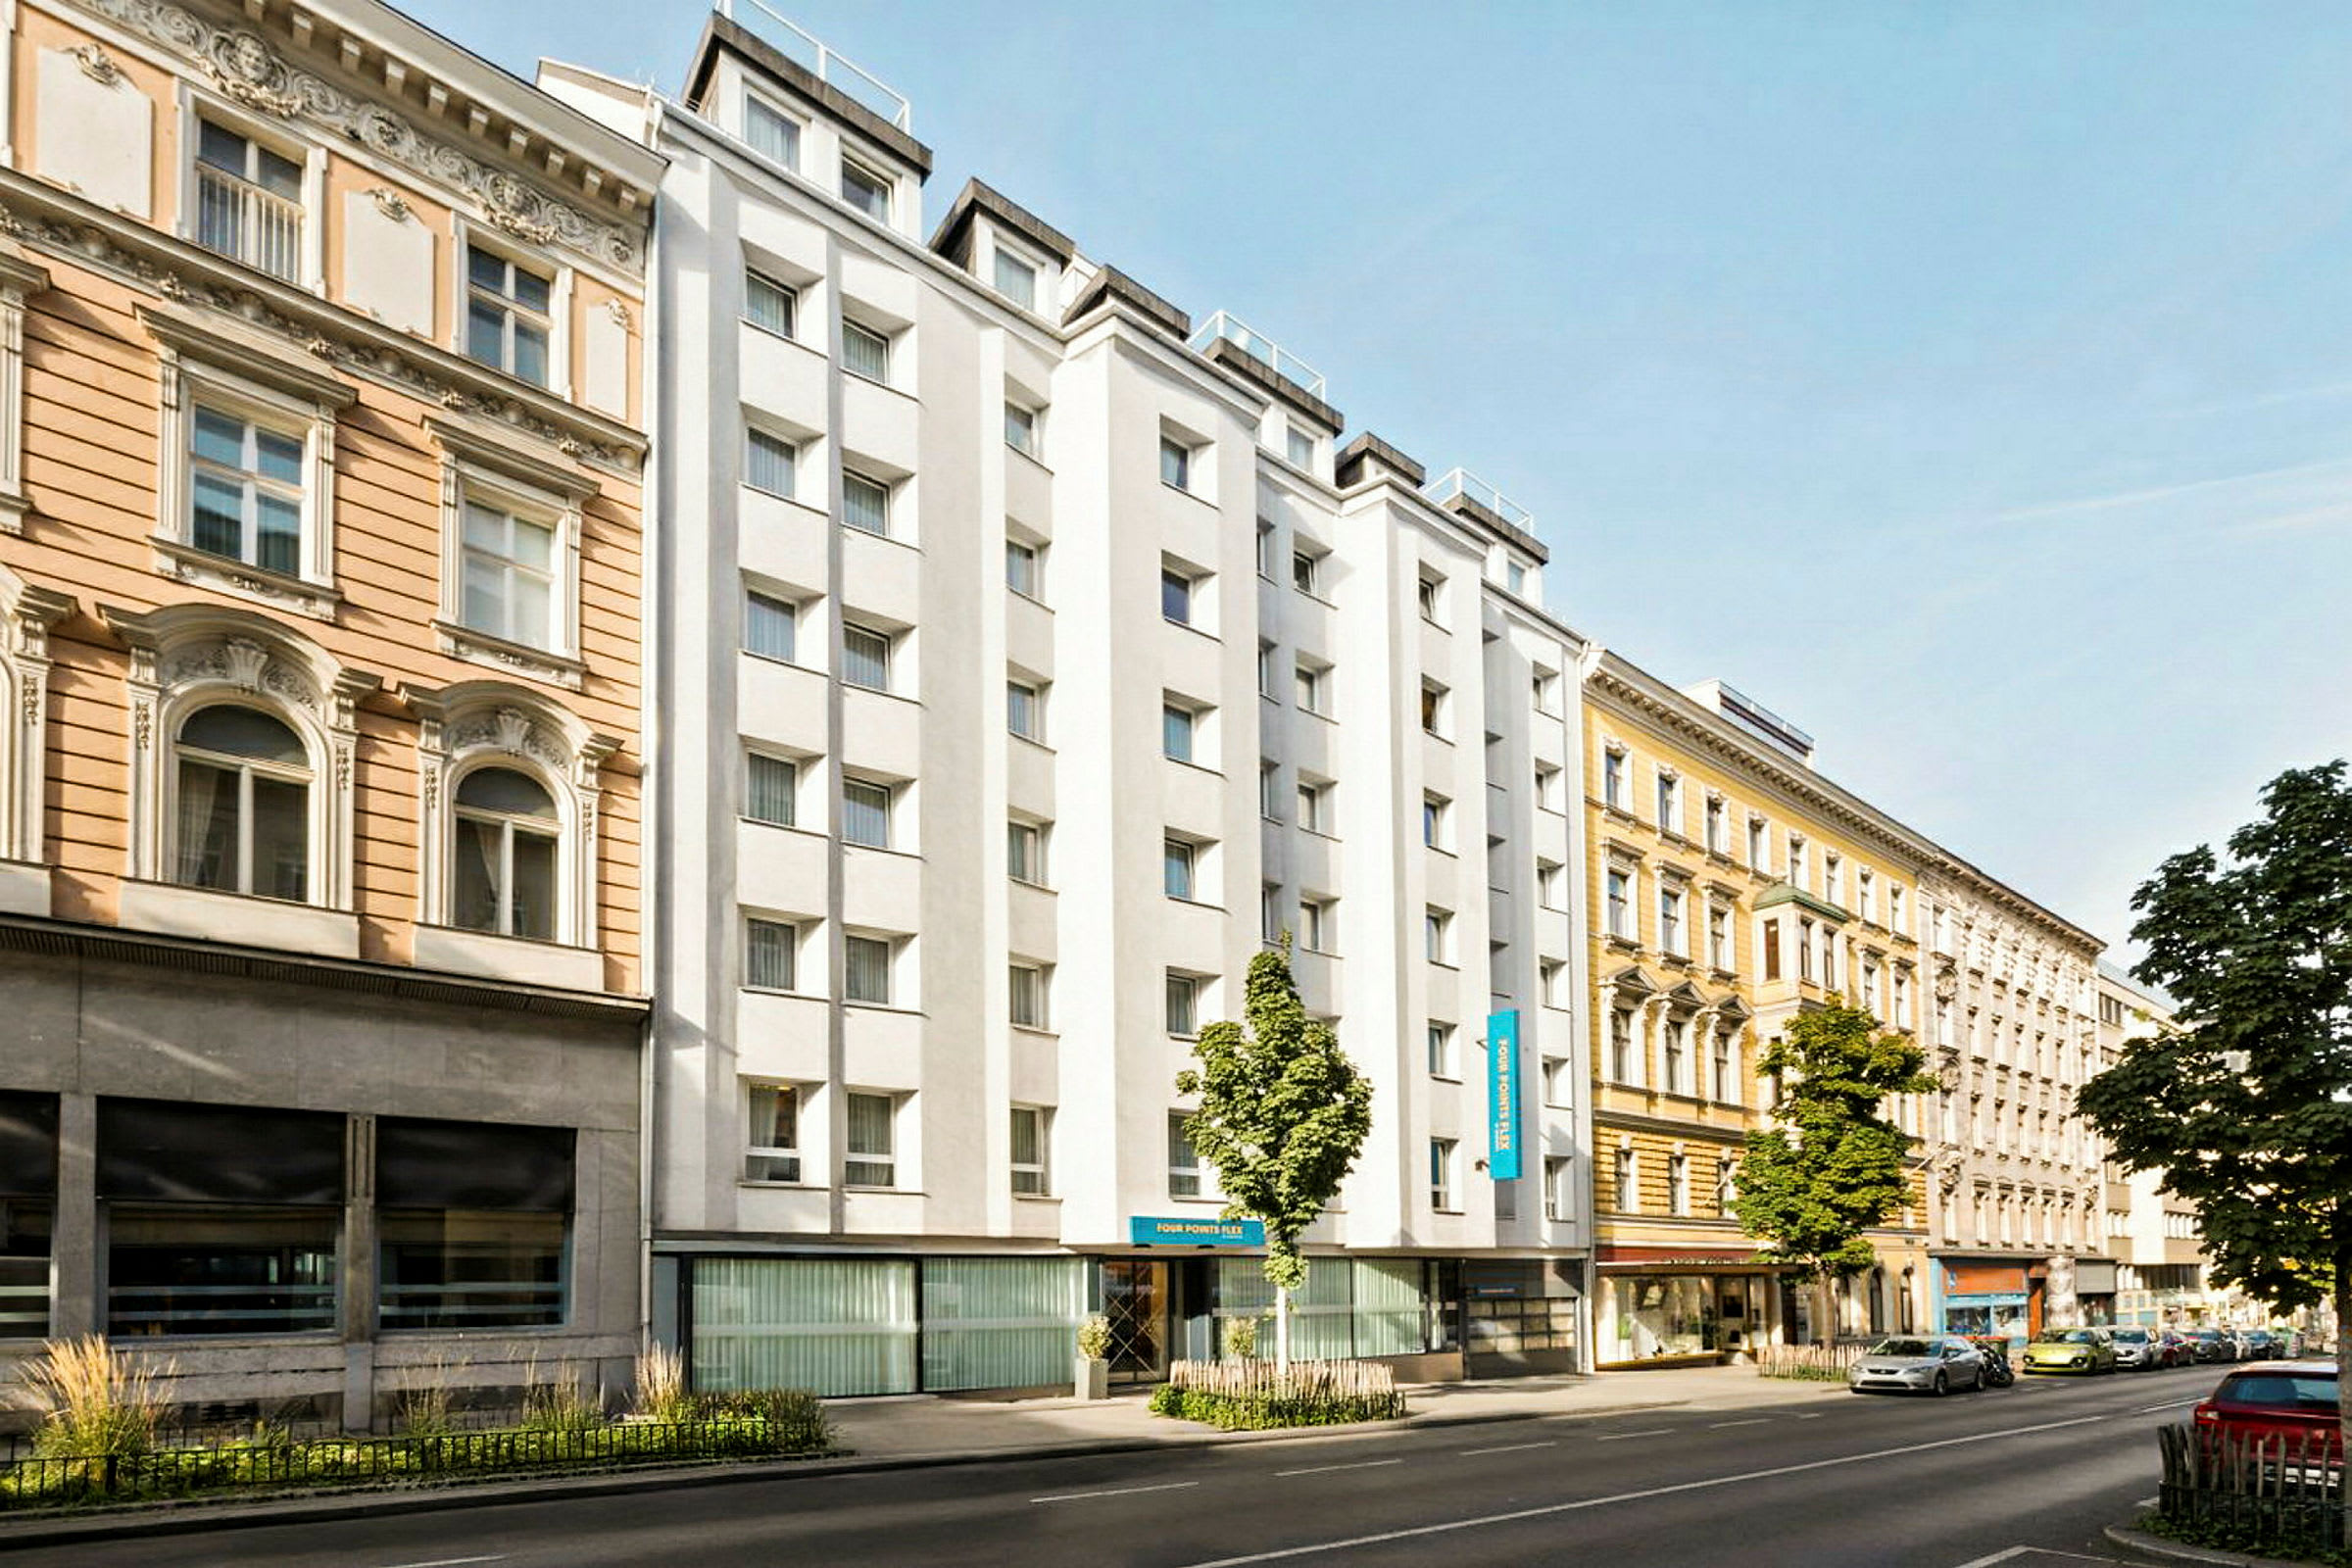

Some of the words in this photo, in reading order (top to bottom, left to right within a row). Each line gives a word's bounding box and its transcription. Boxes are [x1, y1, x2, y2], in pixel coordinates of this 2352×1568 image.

[1497, 1039, 1508, 1072] FOUR
[1498, 1074, 1509, 1119] POINTS
[1499, 1121, 1510, 1150] FLEX
[1156, 1223, 1183, 1233] FOUR
[1185, 1224, 1220, 1234] POINTS
[1222, 1225, 1243, 1235] FLEX
